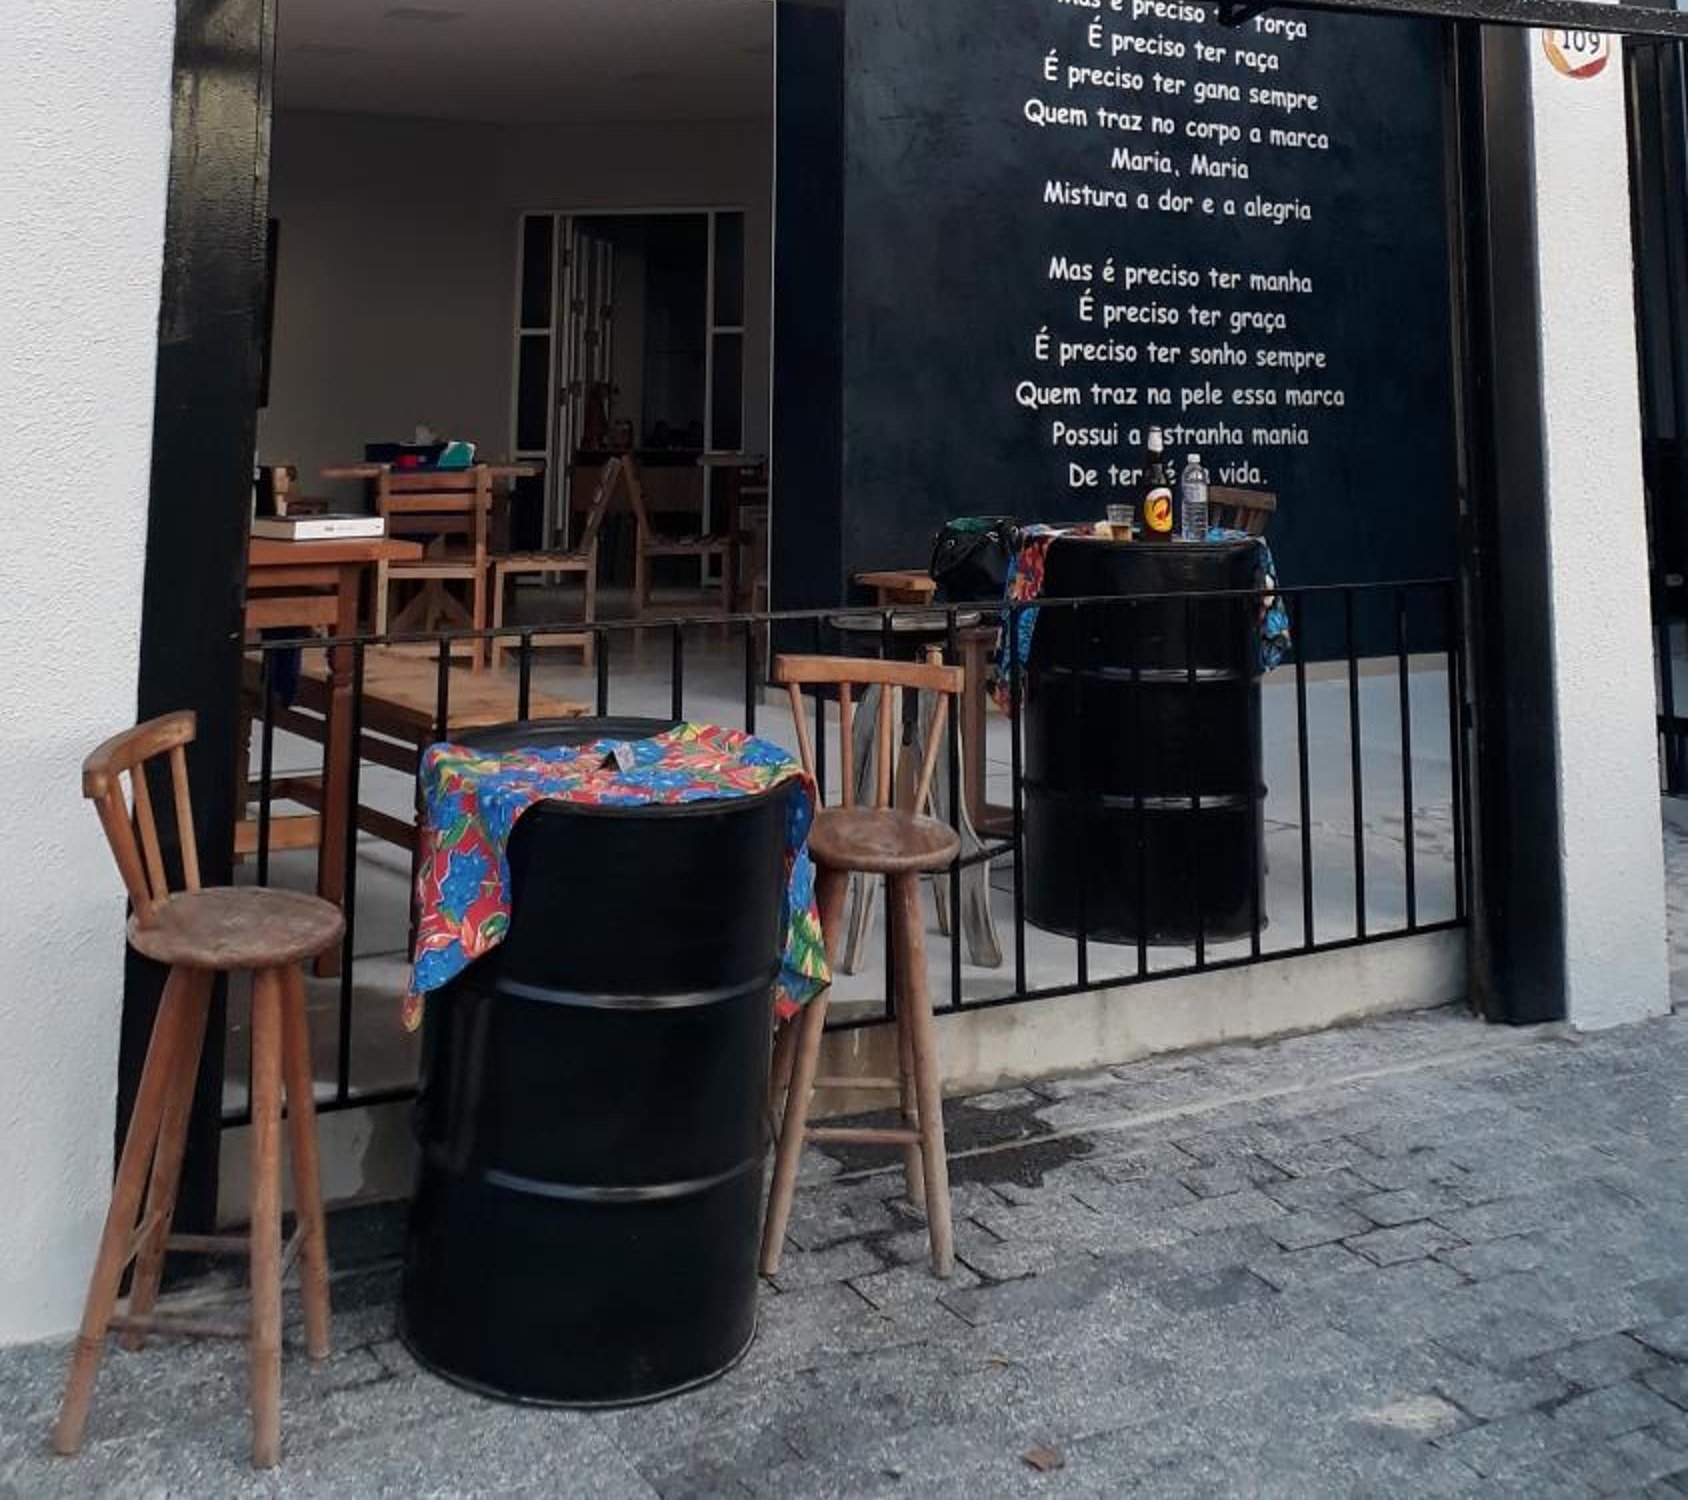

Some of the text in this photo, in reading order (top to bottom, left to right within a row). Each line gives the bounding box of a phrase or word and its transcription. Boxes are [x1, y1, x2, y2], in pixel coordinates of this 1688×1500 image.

[1088, 15, 1279, 73] É preciso ter raça
[1563, 29, 1601, 54] 109
[1043, 48, 1318, 114] É preciso ter gana sempre
[1024, 98, 1329, 149] Quem traz no corpo a marca
[1111, 147, 1249, 179] Maria, Maria
[1044, 180, 1312, 225] Mistura a dor e a alegria
[1048, 255, 1312, 292] Mas é preciso ter manha
[1079, 288, 1286, 334] É preciso ter graça
[1035, 325, 1326, 374] É preciso ter sonho sempre
[1016, 380, 1344, 412] Quem traz na pele essa marca
[1053, 421, 1309, 446] Possui a stranha mania
[1069, 462, 1098, 487] De
[1108, 464, 1143, 486] ter
[1220, 460, 1268, 485] vida.
